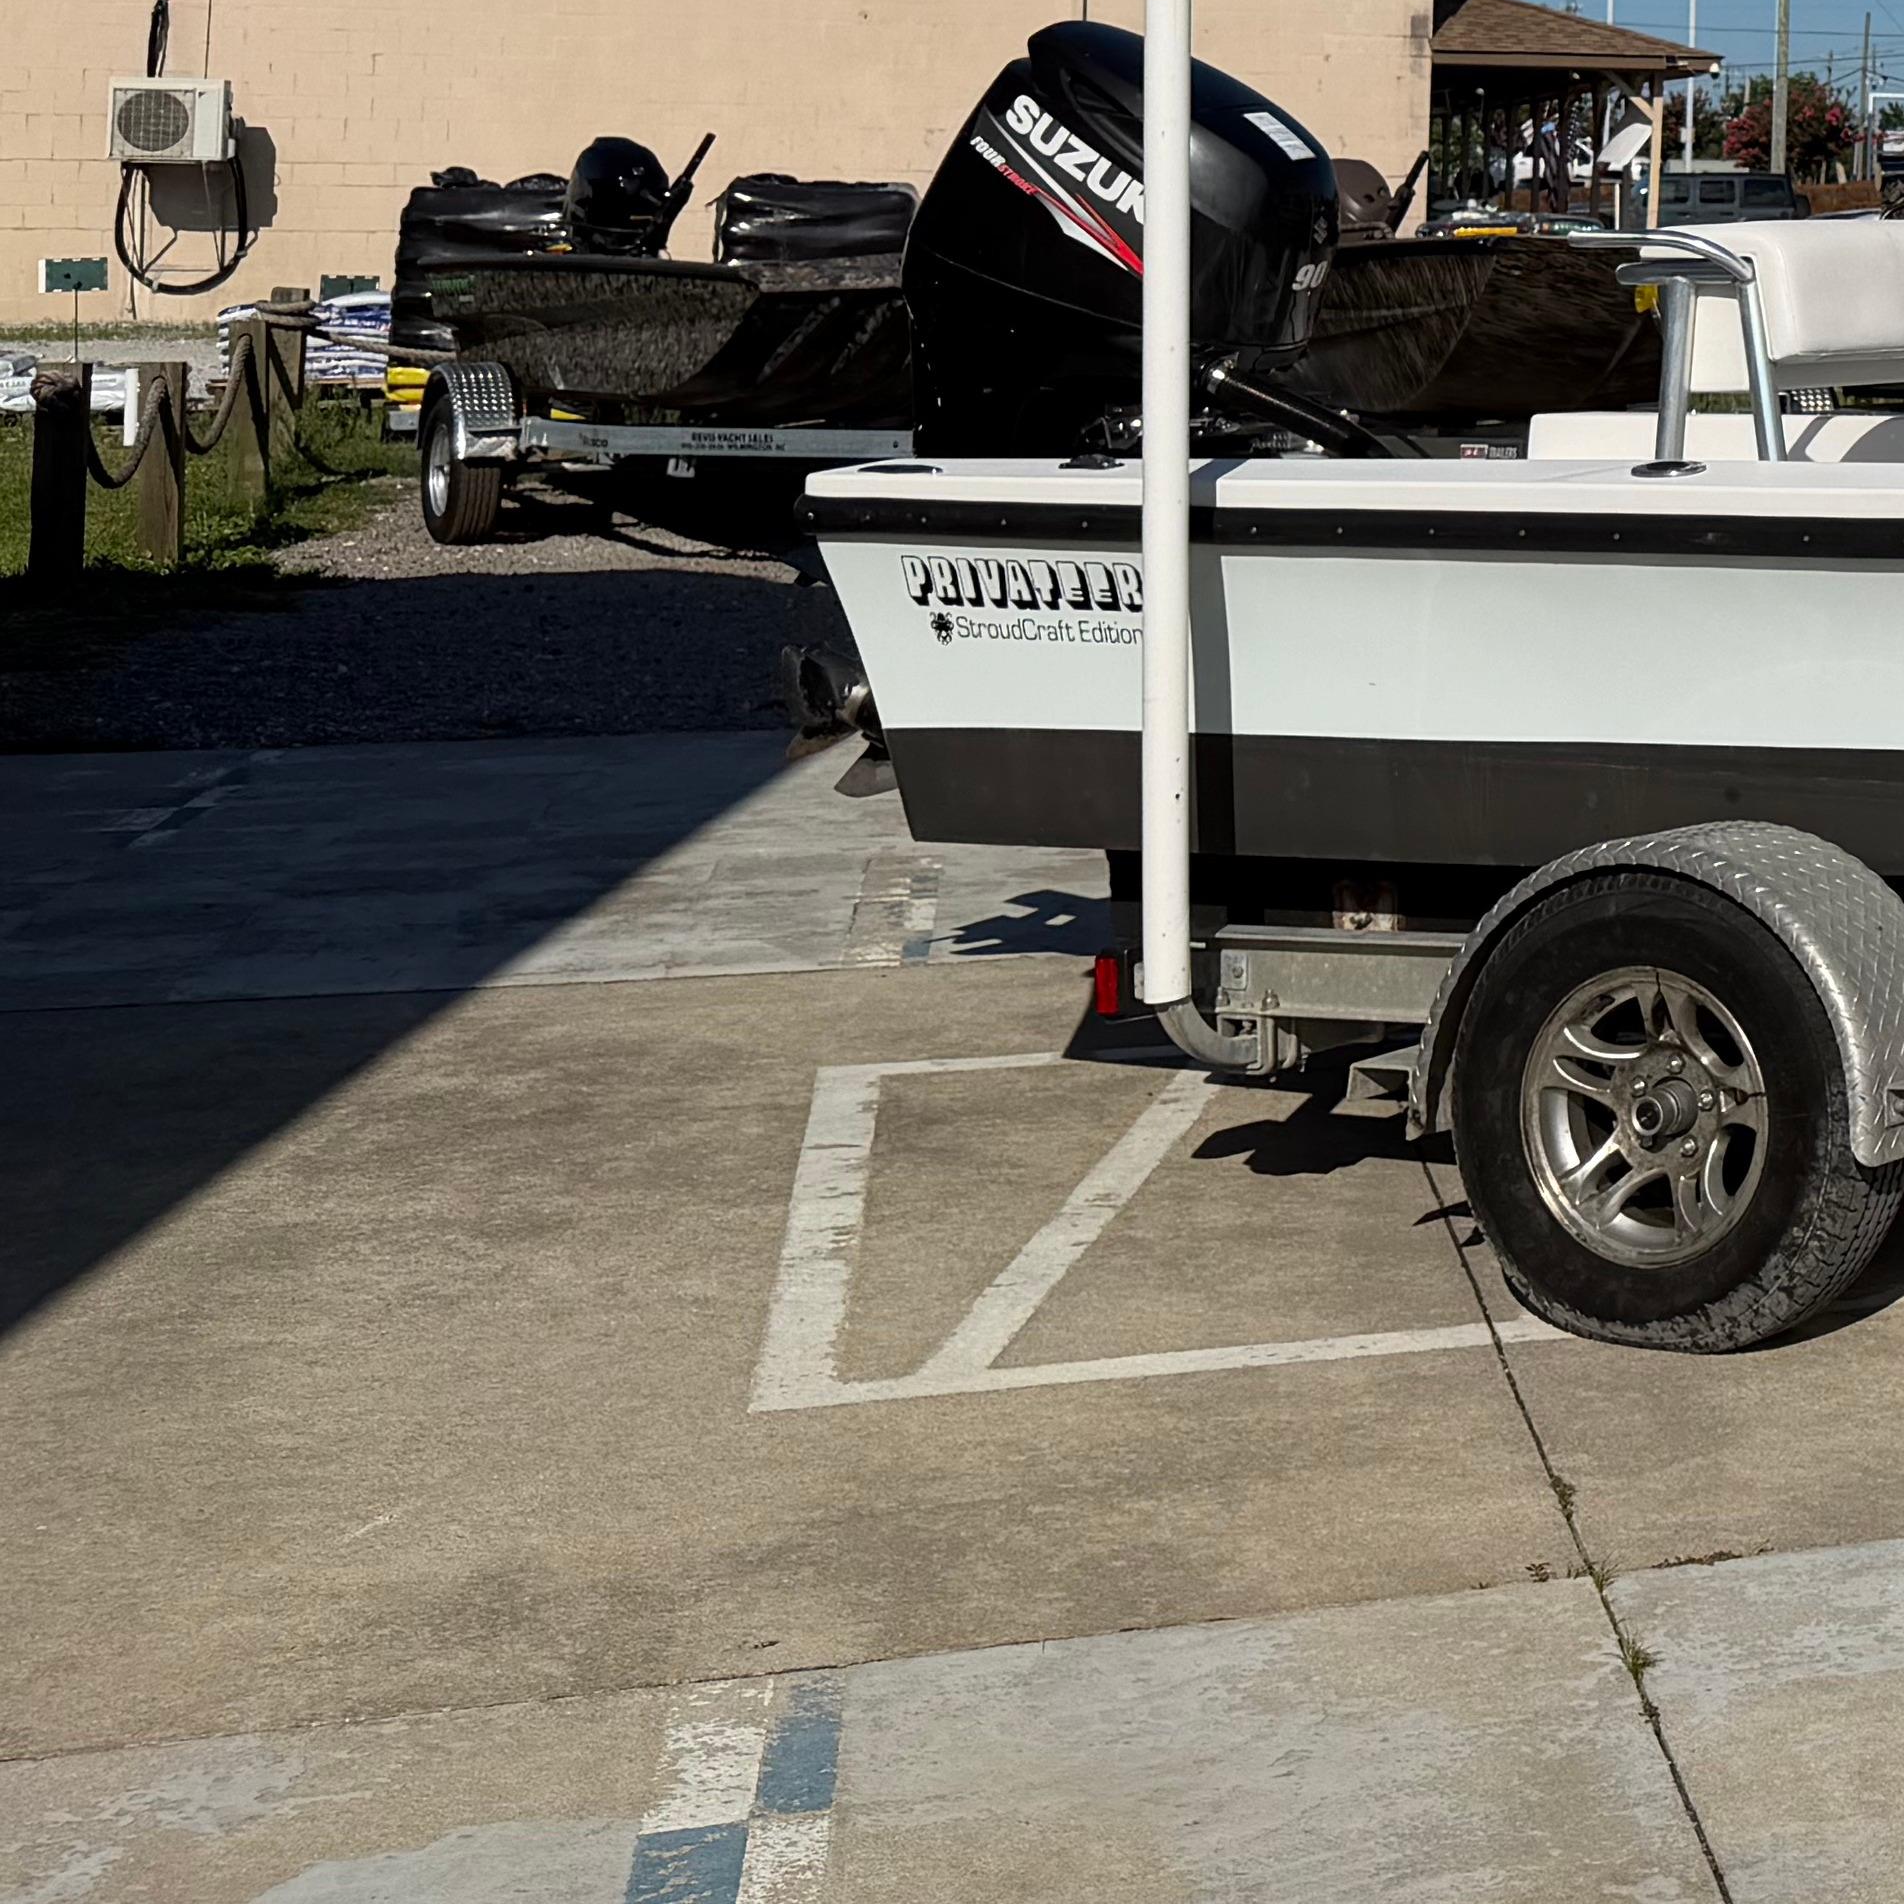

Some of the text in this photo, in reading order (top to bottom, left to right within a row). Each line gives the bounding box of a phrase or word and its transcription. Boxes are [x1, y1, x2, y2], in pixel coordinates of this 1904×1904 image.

[1006, 95, 1144, 225] SUZUK
[1292, 261, 1328, 291] 90
[901, 555, 1142, 613] PRIVATEER
[955, 616, 1142, 645] StroudCraft Edition
